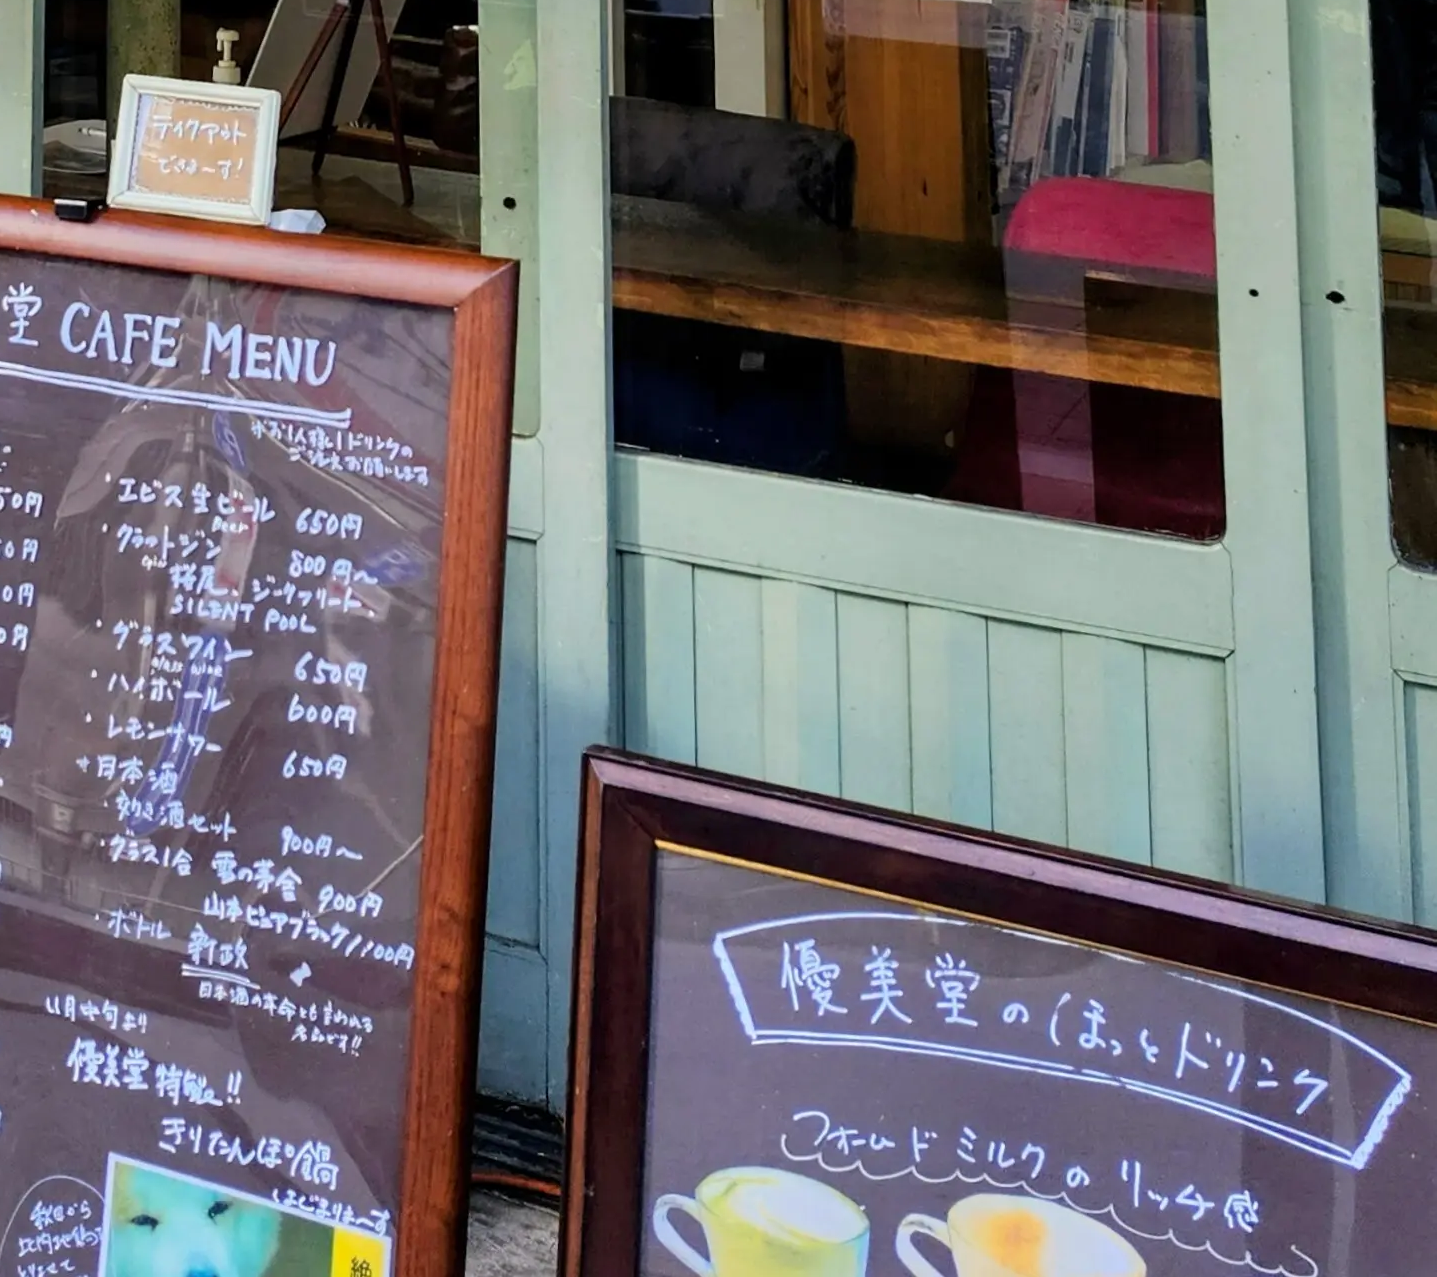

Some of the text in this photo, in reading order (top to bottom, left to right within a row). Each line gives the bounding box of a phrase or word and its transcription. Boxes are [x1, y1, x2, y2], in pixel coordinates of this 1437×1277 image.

[152, 113, 247, 146] テイクアウト
[60, 301, 182, 367] CAFE
[201, 322, 337, 387] MENU
[294, 505, 363, 540] 650円
[169, 593, 317, 635] SILENT POOL
[294, 650, 368, 693] 650円
[106, 673, 358, 735] ハイボール 600円
[107, 712, 223, 758] レモンサワー
[281, 749, 349, 781] 650円
[318, 884, 384, 919] 900円
[66, 1036, 151, 1091] 優美堂
